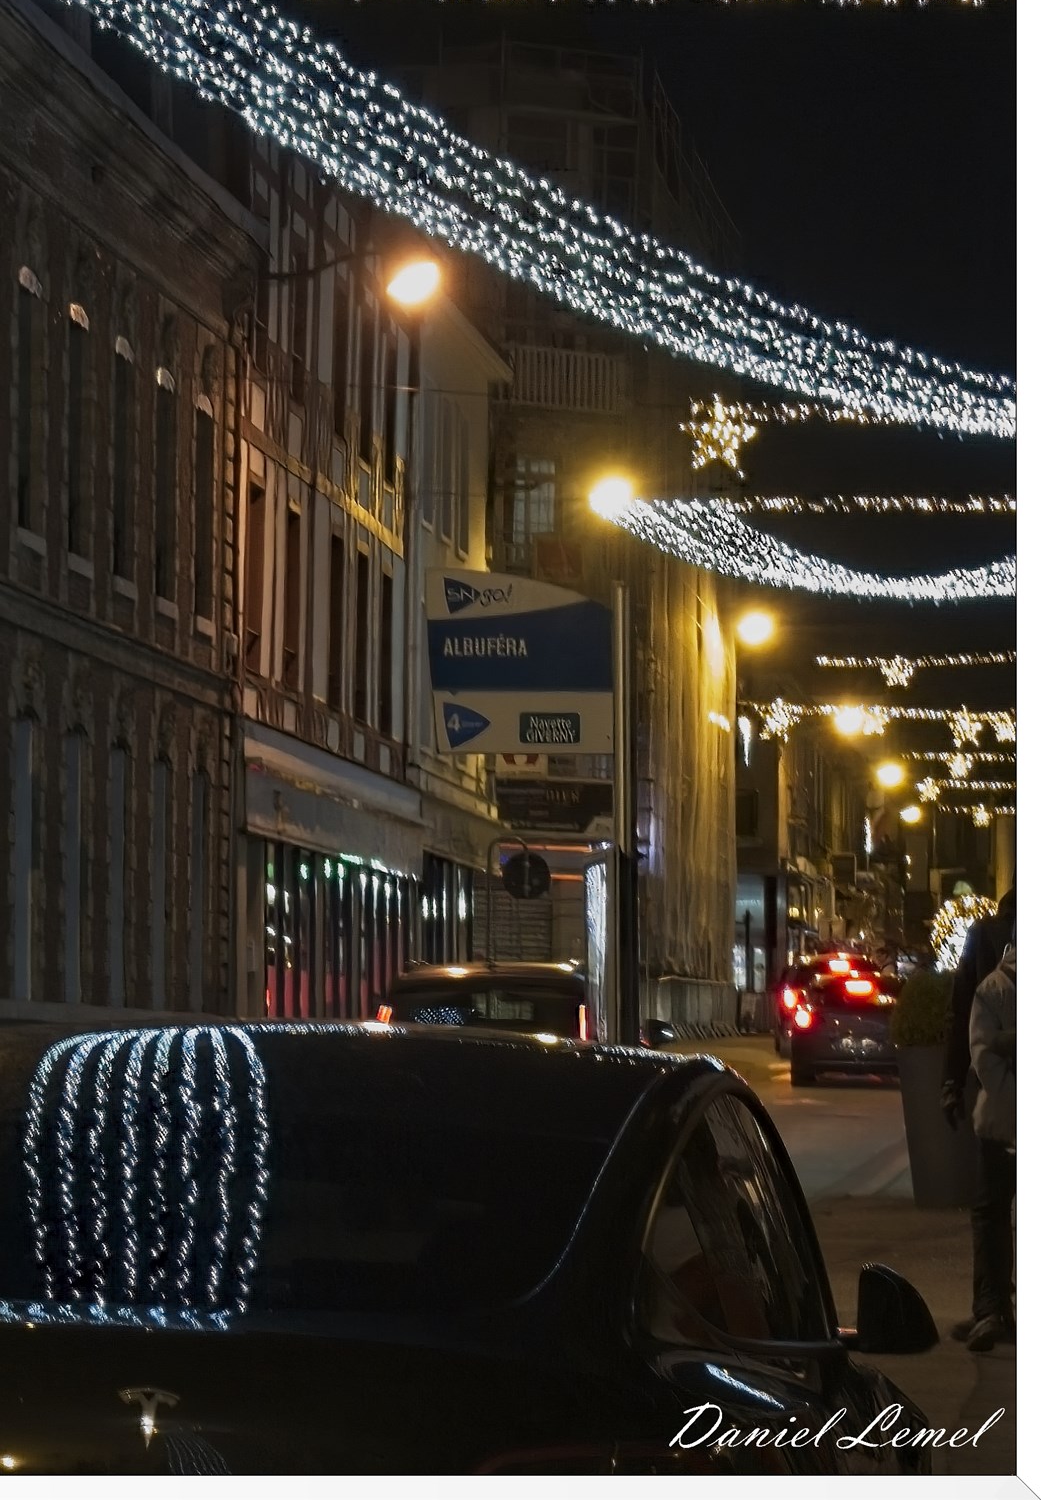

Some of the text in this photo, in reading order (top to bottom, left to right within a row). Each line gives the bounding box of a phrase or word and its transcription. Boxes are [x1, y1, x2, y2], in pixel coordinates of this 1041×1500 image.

[444, 633, 528, 658] ALBUFÉRA
[447, 713, 461, 733] 4
[529, 716, 572, 731] Navette
